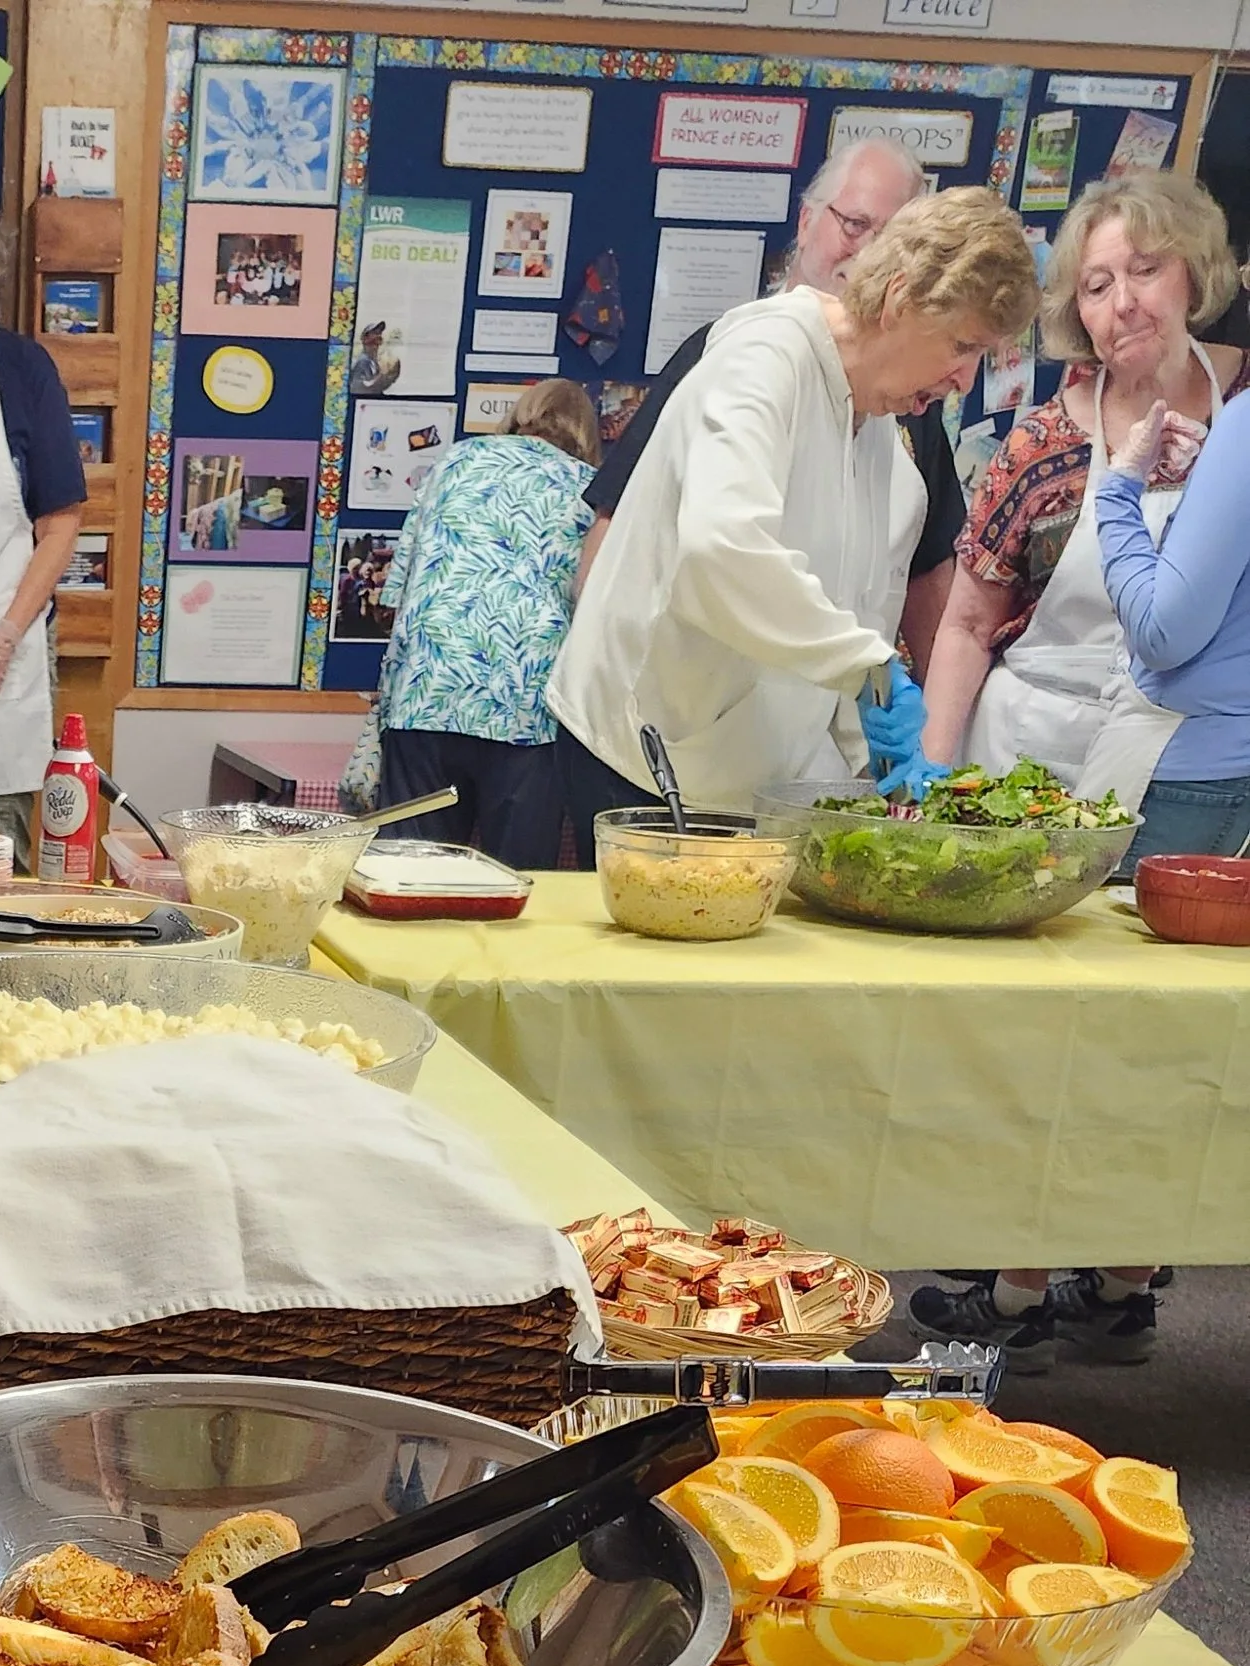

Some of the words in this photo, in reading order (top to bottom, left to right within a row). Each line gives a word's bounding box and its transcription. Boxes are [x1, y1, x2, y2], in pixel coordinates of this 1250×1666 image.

[680, 107, 704, 123] ALL
[709, 108, 763, 124] WOMEN
[766, 110, 780, 125] of
[670, 127, 719, 145] PRINCE
[722, 131, 736, 145] of
[370, 205, 405, 224] LWR
[370, 243, 401, 261] BIG
[407, 245, 459, 264] DEAL!
